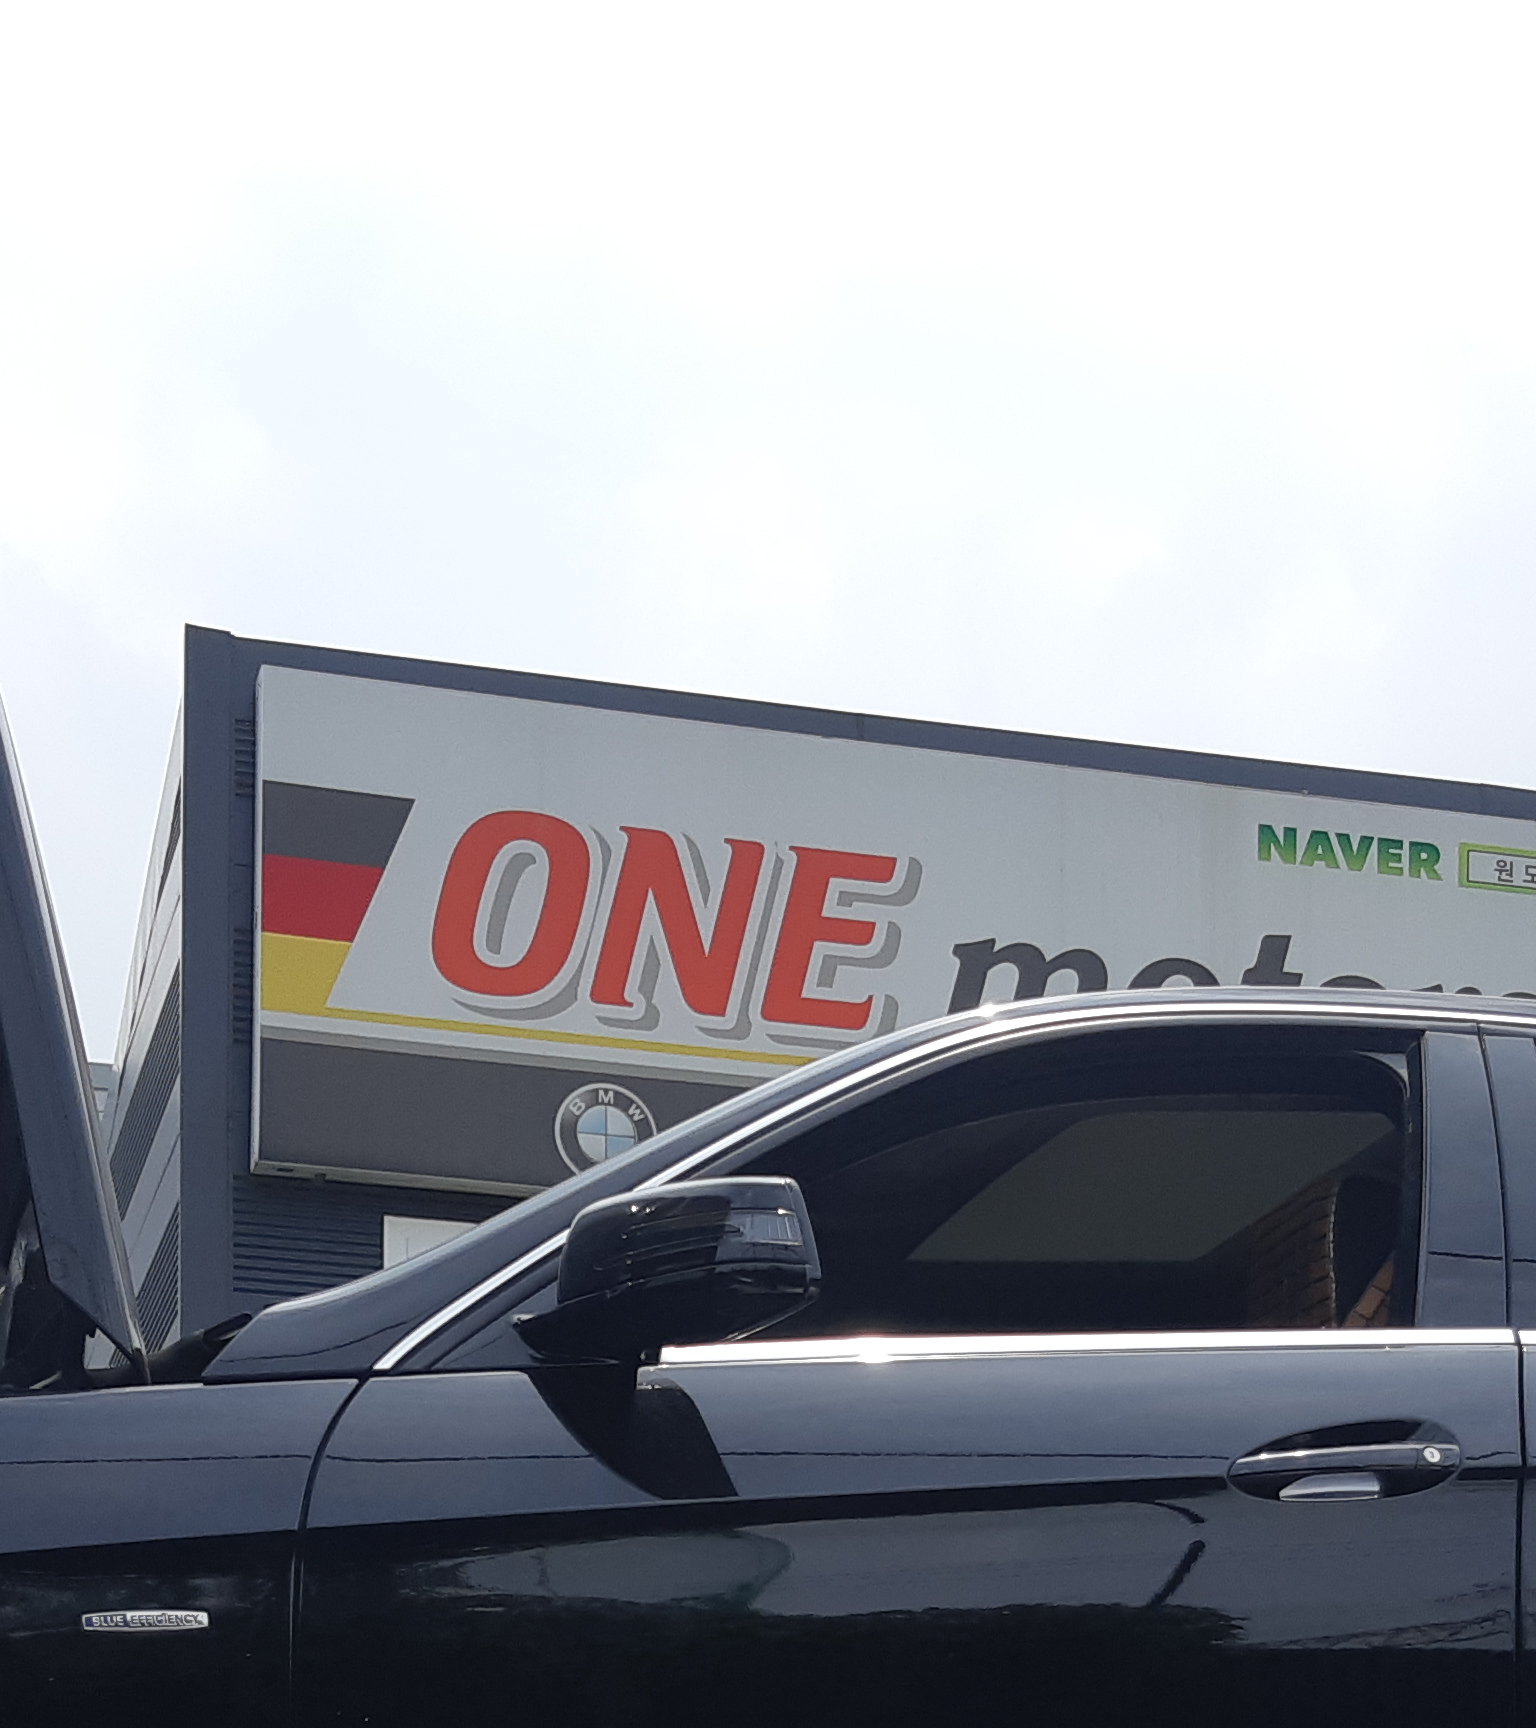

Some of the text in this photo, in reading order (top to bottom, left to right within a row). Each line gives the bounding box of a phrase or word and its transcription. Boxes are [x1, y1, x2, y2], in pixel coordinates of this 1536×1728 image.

[1257, 824, 1443, 881] NAVER
[1494, 859, 1515, 883] 원
[431, 810, 904, 1034] ONE
[569, 1089, 645, 1121] BMW
